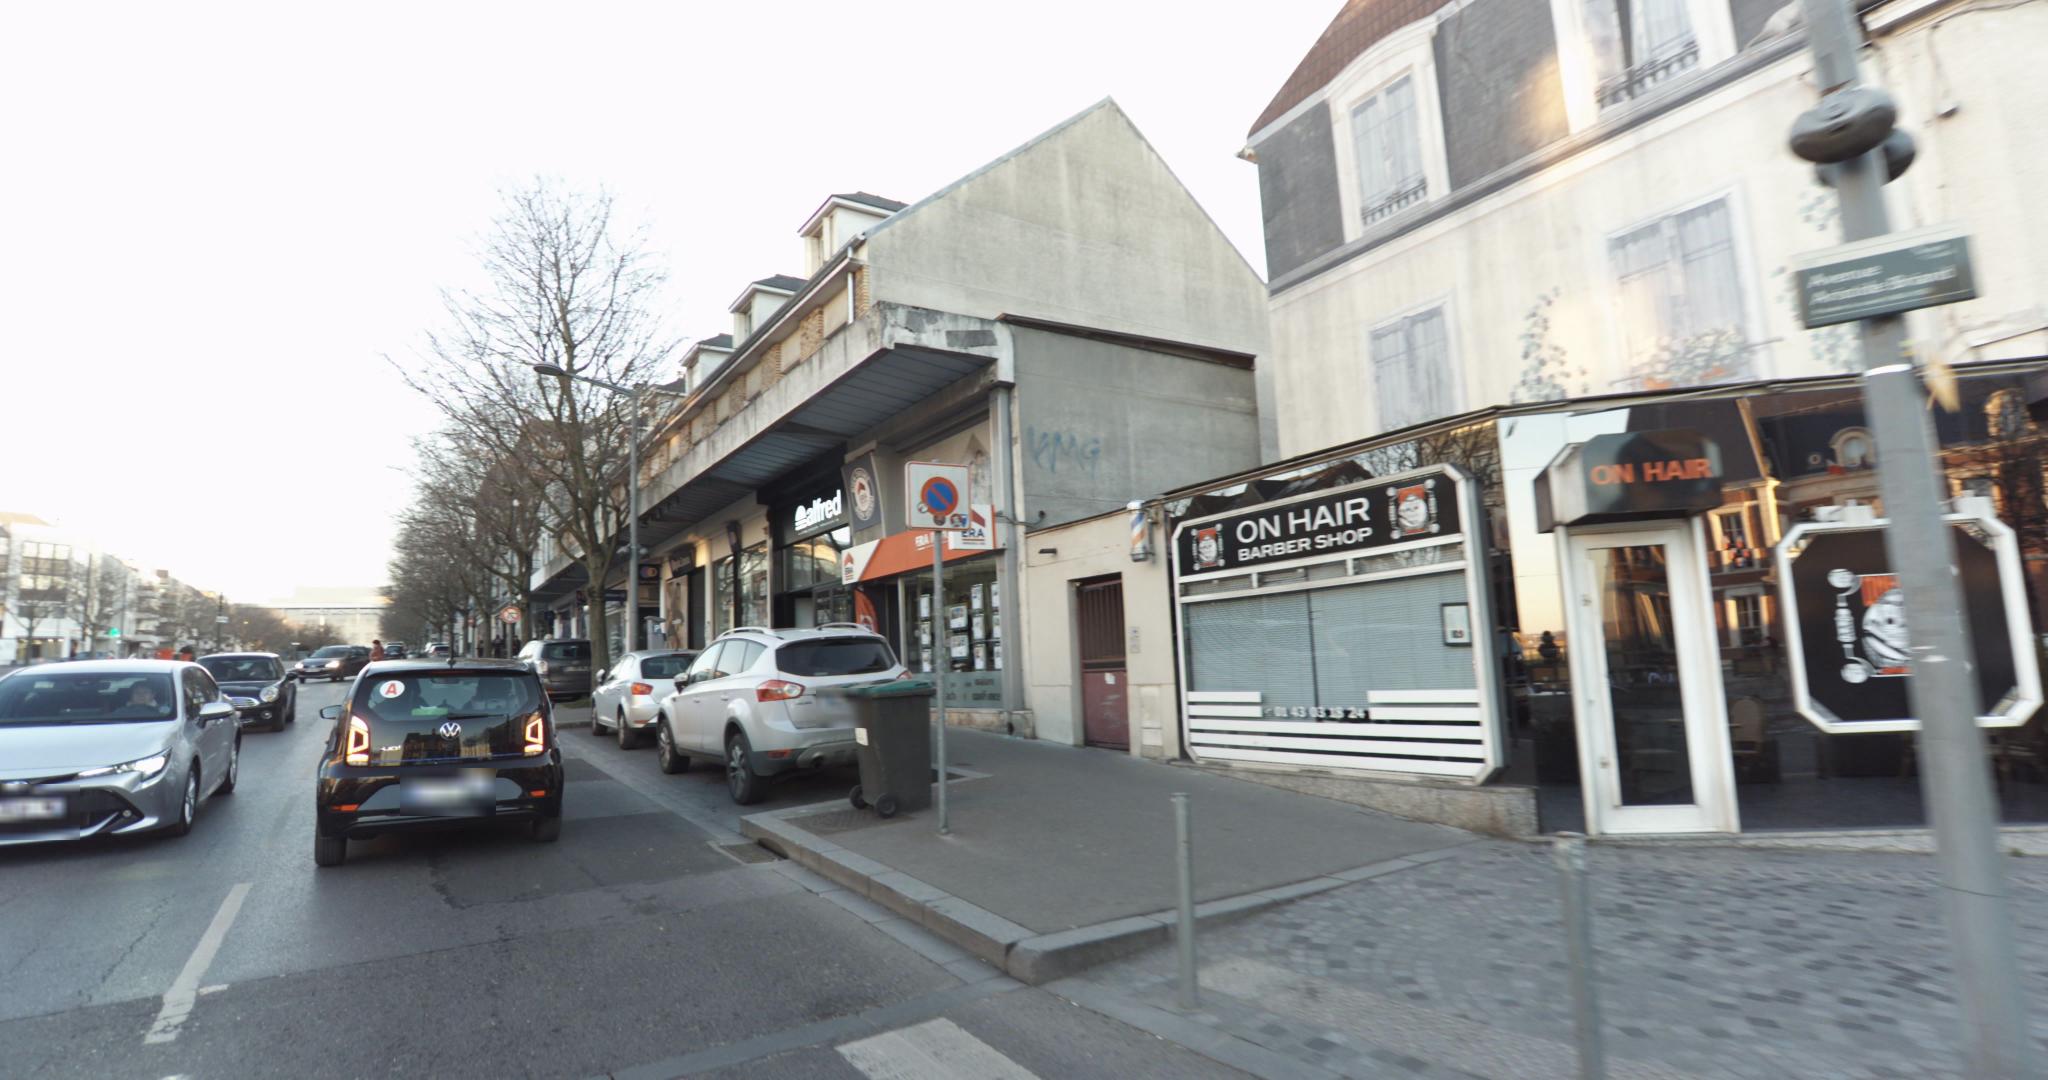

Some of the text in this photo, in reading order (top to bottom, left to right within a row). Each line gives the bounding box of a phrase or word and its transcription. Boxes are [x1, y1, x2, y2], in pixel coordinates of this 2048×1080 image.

[1590, 458, 1712, 485] ON HAIR
[806, 489, 842, 525] alfred
[1236, 497, 1370, 543] ON HAIR
[961, 528, 985, 538] ERA
[1238, 527, 1373, 561] BARBER SHOP
[385, 683, 398, 696] A
